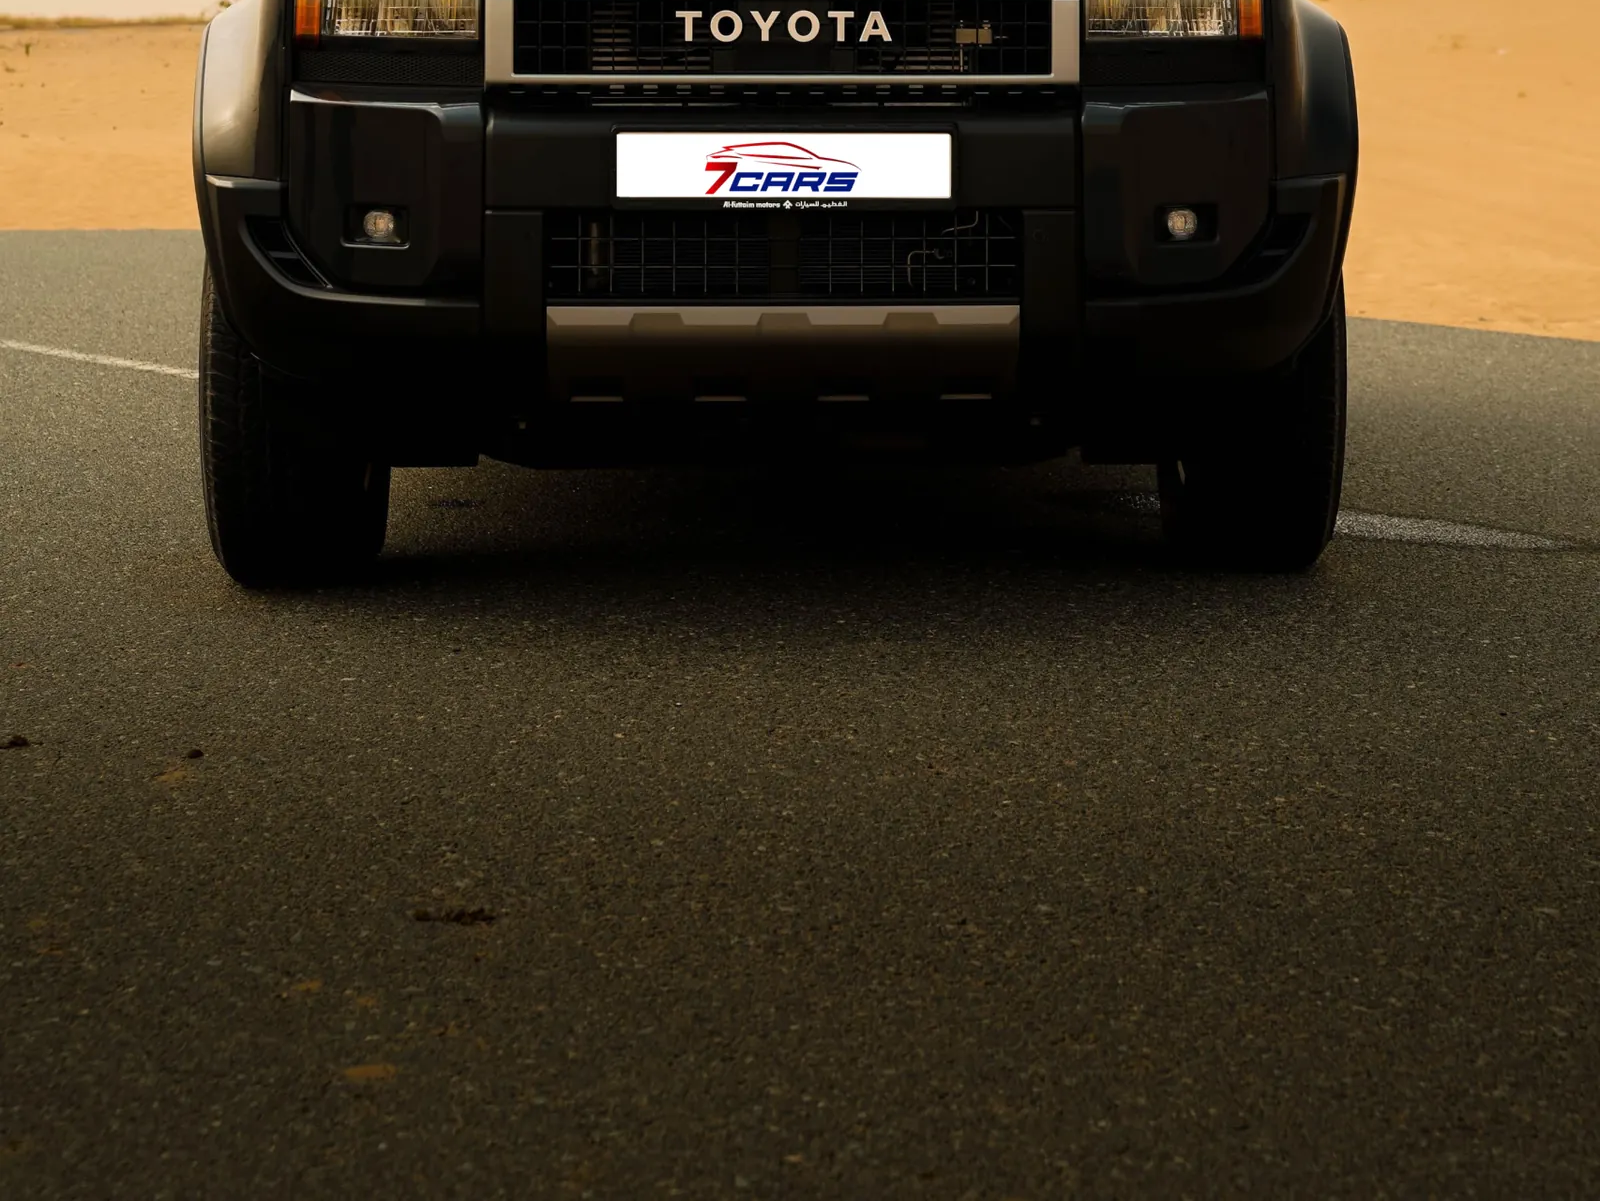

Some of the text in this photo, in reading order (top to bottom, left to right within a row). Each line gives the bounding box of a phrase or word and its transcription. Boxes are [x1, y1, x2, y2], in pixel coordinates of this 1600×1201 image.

[675, 9, 893, 43] TOYOTA
[705, 161, 859, 195] 7CARS
[756, 201, 781, 209] motors
